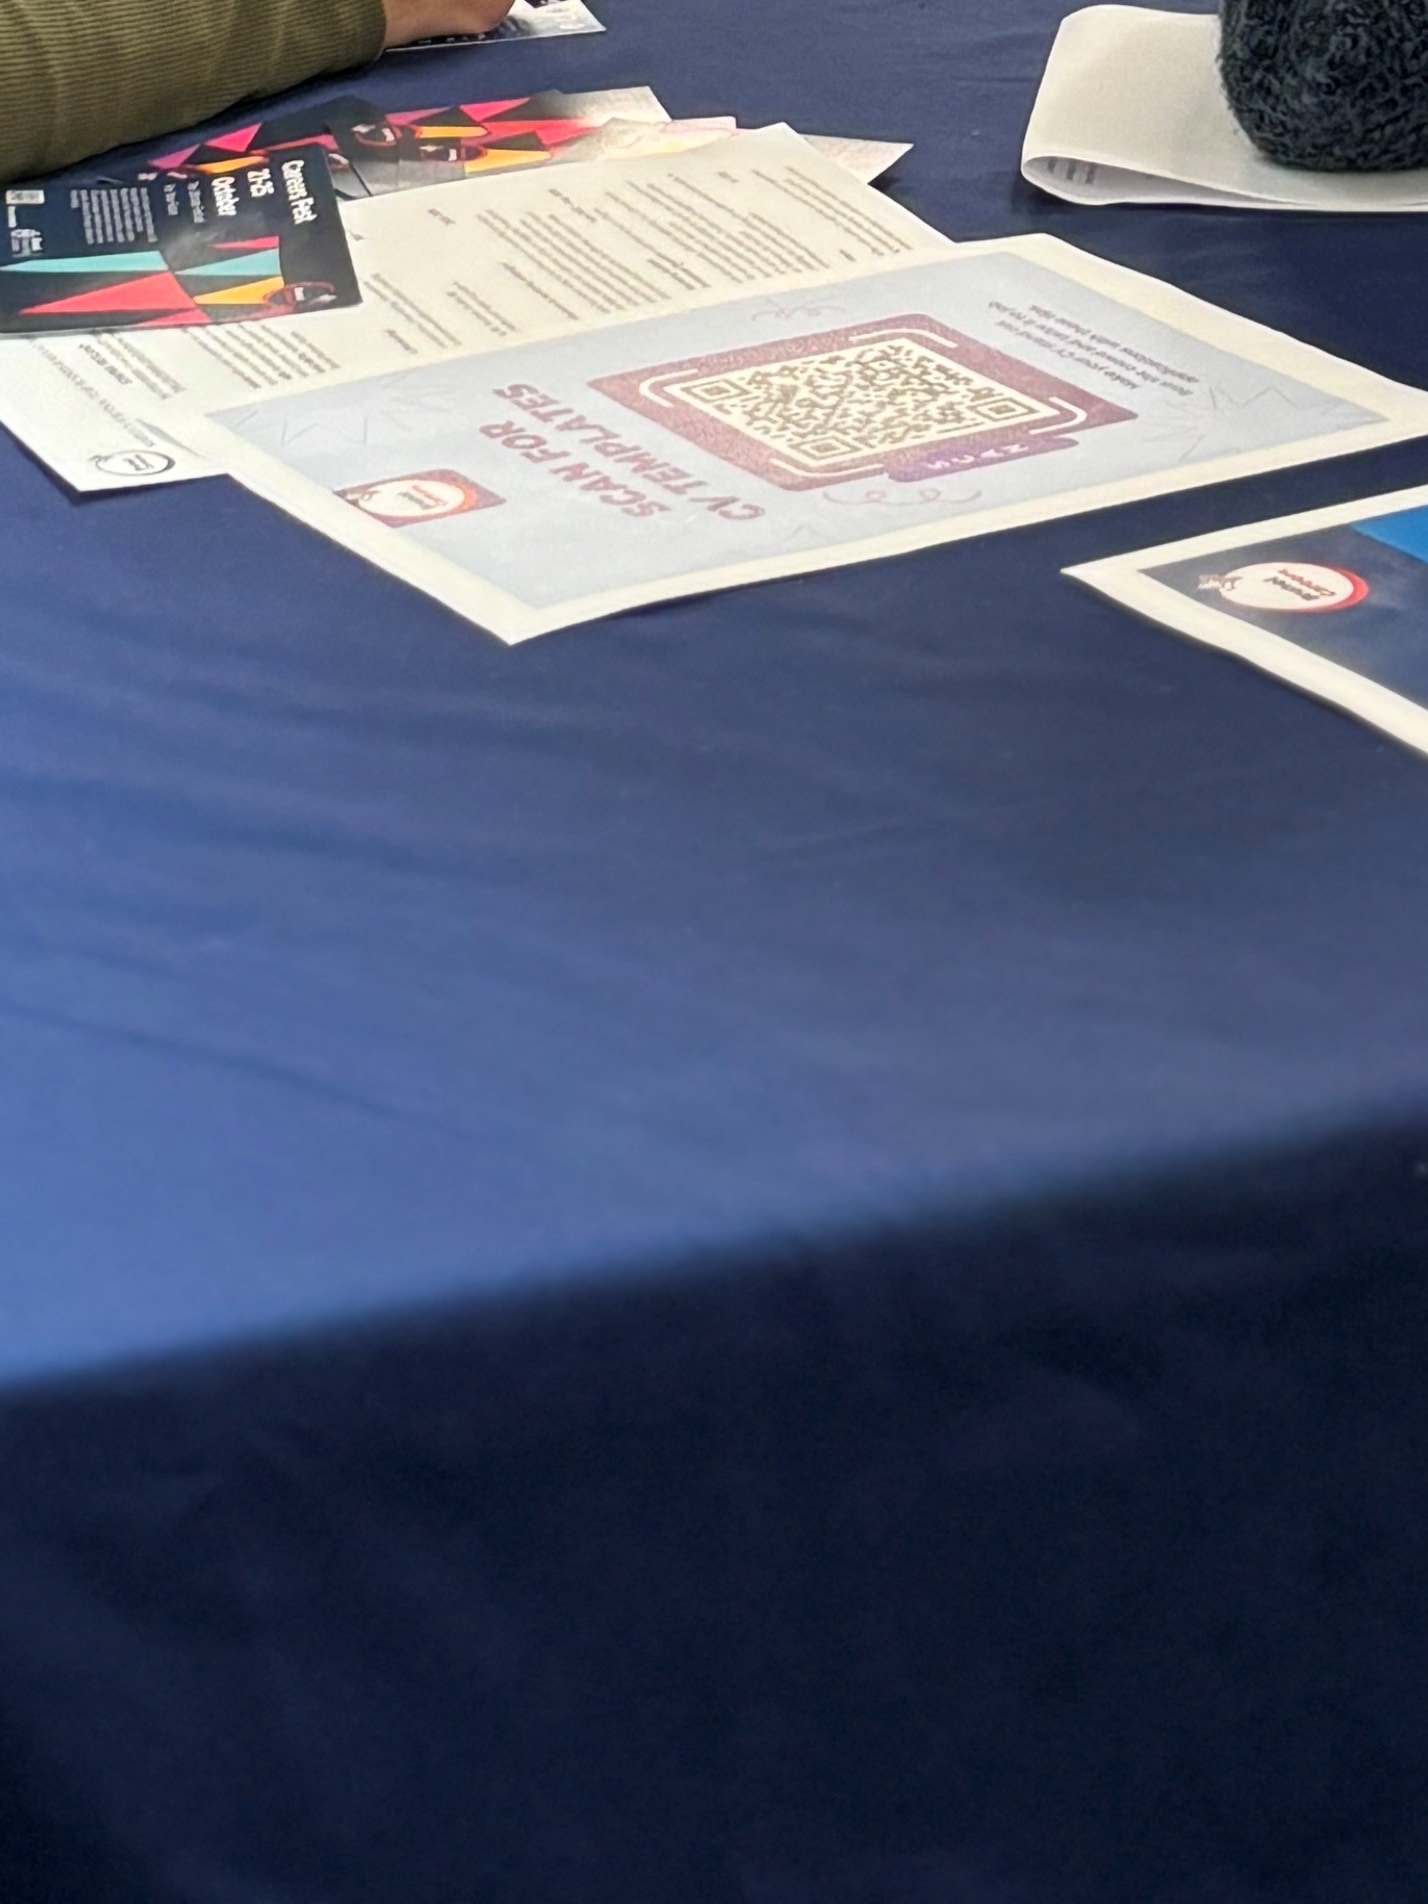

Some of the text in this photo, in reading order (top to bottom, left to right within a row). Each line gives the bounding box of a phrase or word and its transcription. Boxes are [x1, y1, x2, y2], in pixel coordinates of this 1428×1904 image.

[212, 175, 239, 217] October
[479, 419, 672, 517] SCAN FOR
[492, 383, 766, 521] CV TEMPLATES
[1263, 576, 1320, 601] Brunel
